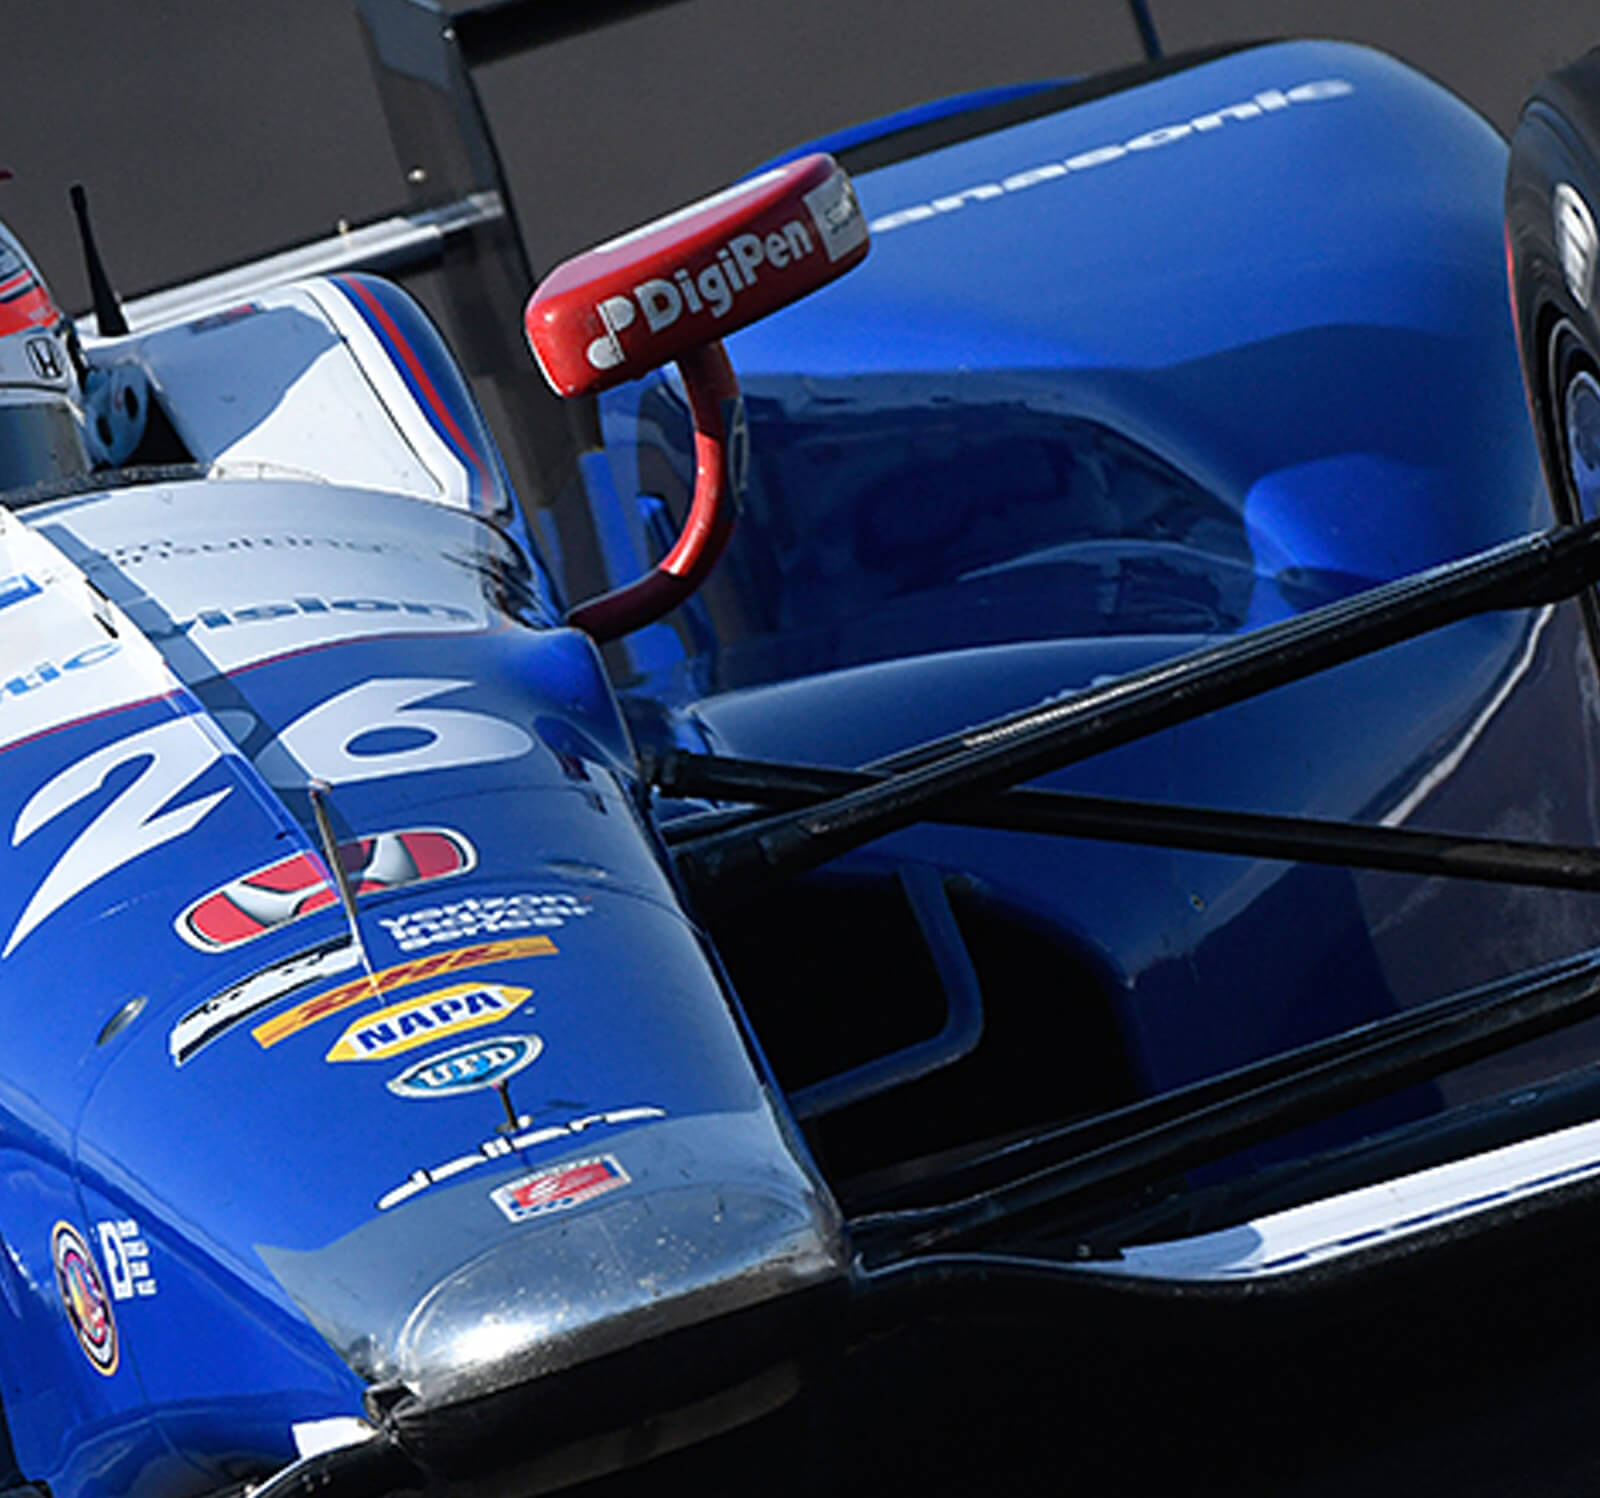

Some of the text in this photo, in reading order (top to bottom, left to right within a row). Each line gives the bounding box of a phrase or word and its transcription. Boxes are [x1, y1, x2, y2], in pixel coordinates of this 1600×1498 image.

[869, 78, 1353, 233] anasonic
[633, 219, 814, 333] DigiPen
[2, 676, 536, 959] 26
[356, 990, 503, 1053] NAPA
[377, 1106, 667, 1210] dallara
